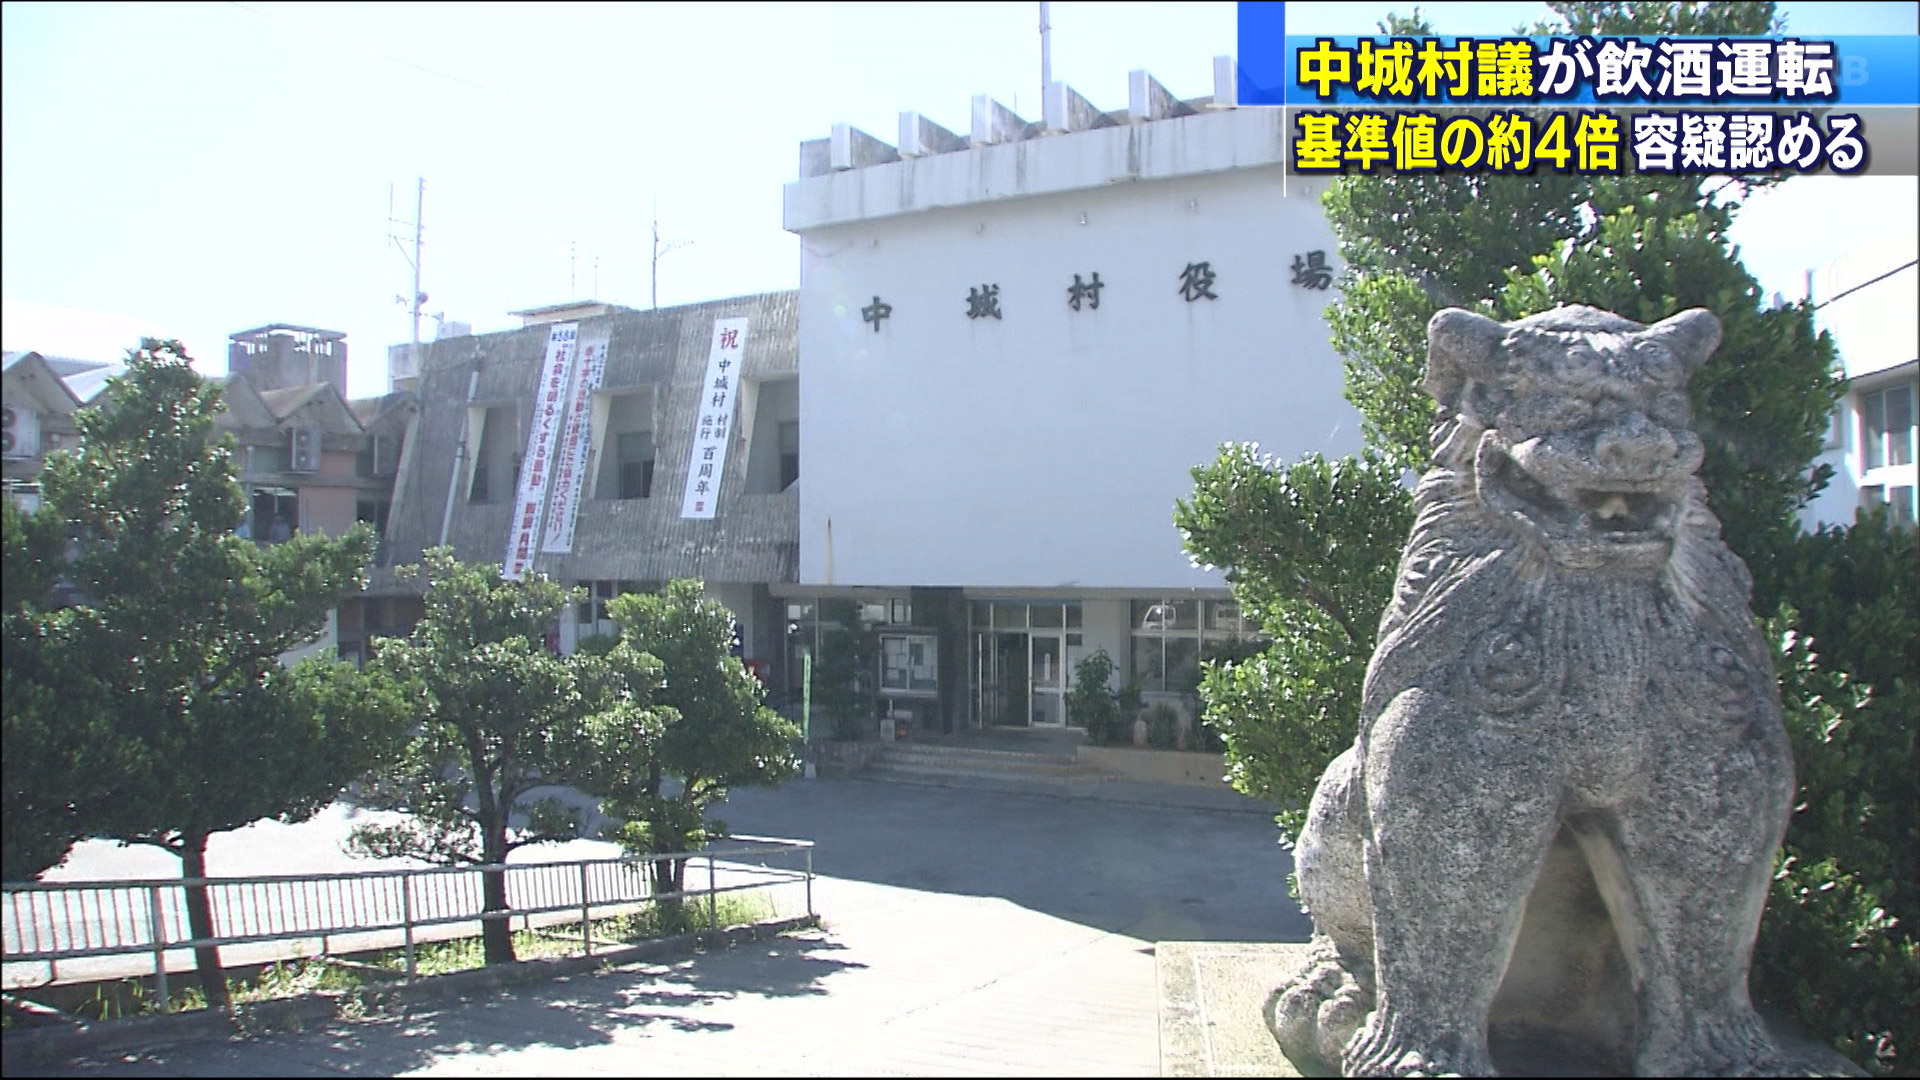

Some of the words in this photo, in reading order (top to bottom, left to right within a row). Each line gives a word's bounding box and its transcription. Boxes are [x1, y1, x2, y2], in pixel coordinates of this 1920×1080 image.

[861, 250, 1333, 332] 中城村役場
[720, 327, 739, 350] 祝
